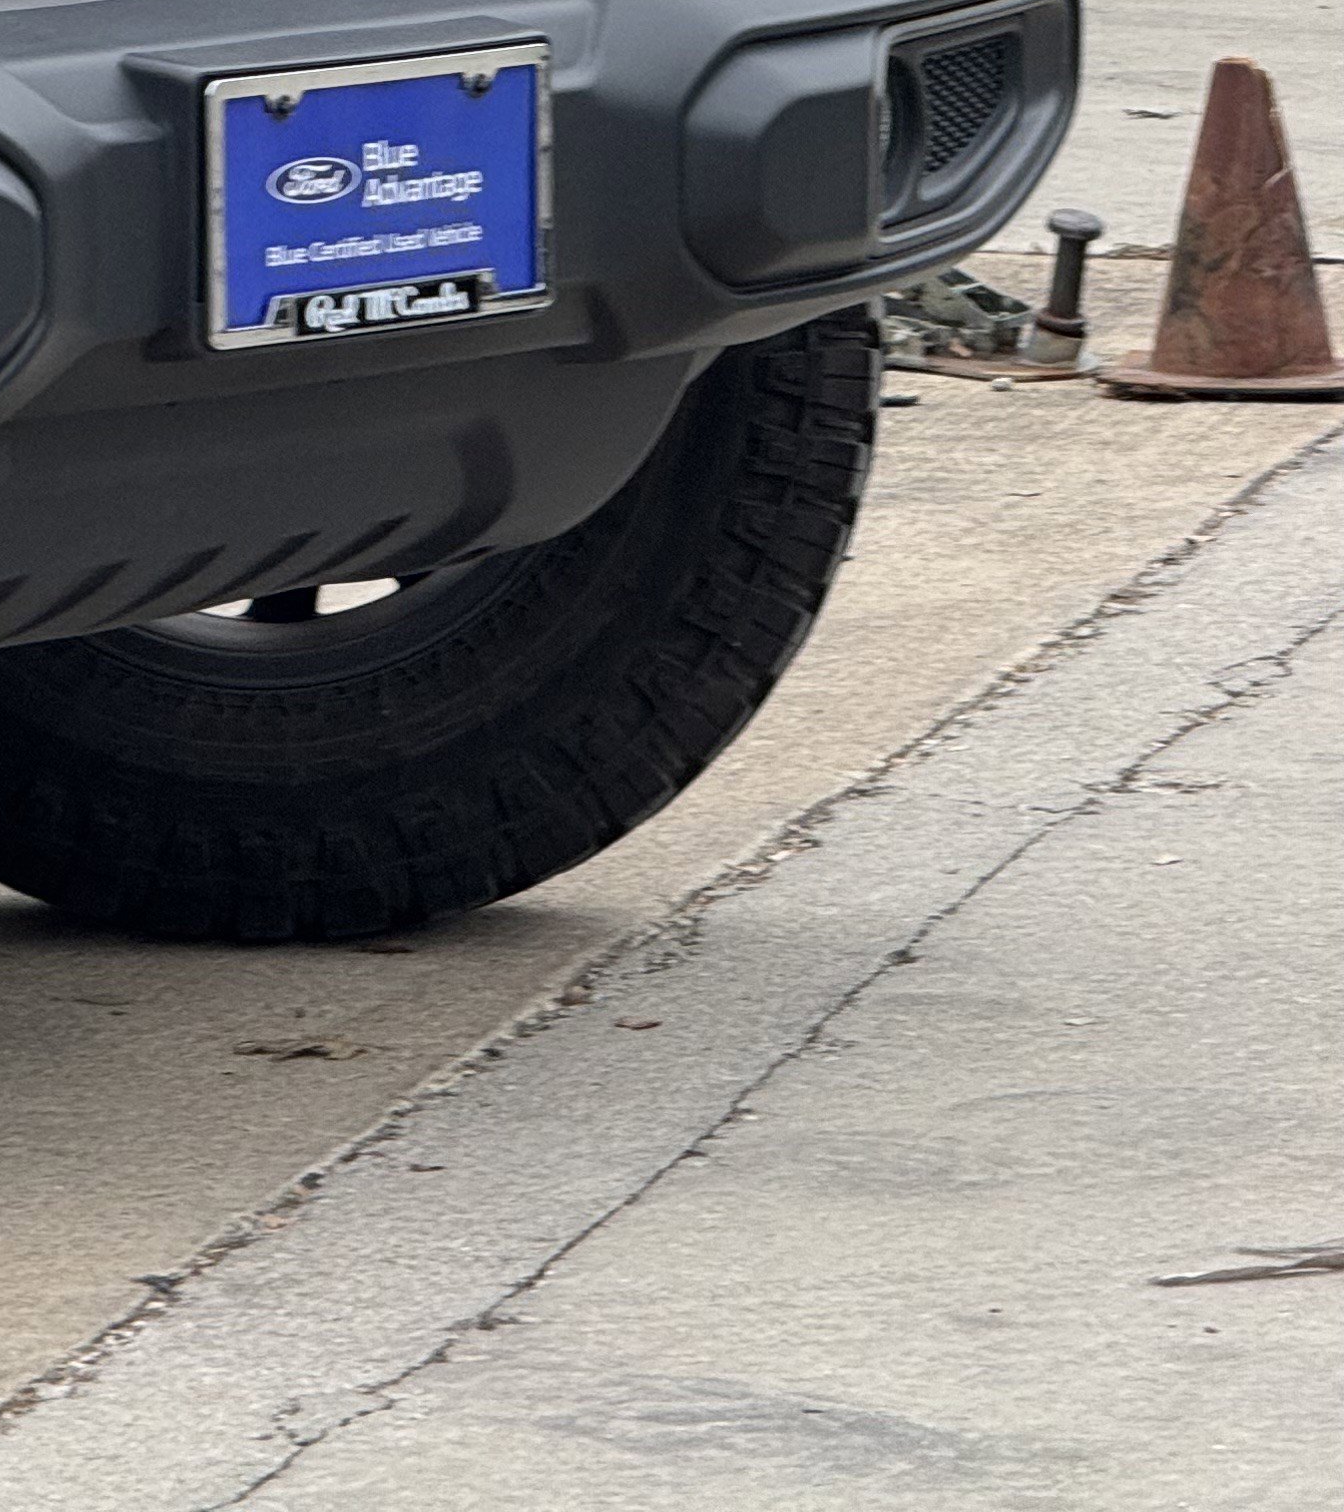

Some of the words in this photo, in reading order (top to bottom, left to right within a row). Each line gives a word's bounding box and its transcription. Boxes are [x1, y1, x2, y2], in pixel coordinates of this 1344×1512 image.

[363, 140, 419, 171] Blue
[278, 161, 349, 198] Ford
[362, 171, 484, 207] Advantage
[265, 245, 308, 267] Blue
[308, 236, 384, 262] Certified
[384, 232, 426, 253] Used
[426, 222, 483, 247] Vehicle
